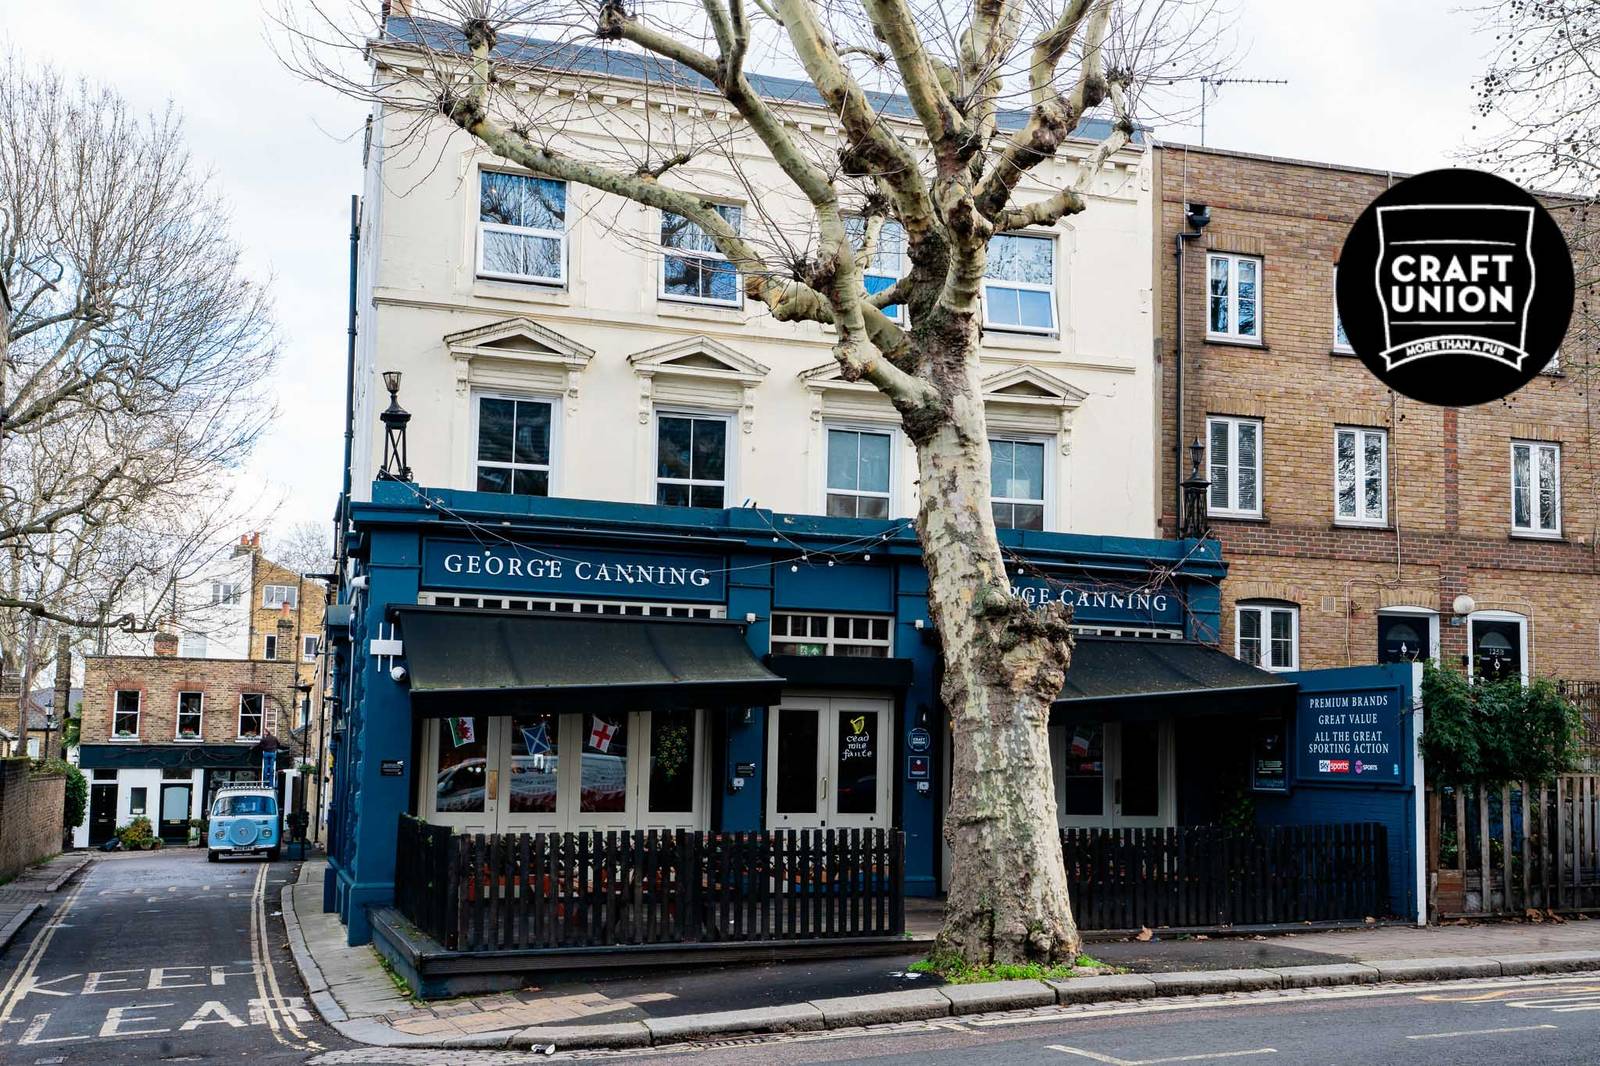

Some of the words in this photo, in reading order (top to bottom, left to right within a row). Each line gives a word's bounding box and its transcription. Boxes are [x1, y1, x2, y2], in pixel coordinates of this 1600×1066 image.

[444, 554, 563, 579] GEORGE
[575, 562, 709, 587] CANNING
[1060, 589, 1168, 612] CANNING
[1309, 698, 1348, 708] PREMIUM
[1352, 696, 1388, 706] BRANDS
[1318, 715, 1346, 724] GREAT
[1349, 714, 1378, 723] VALUE
[1315, 732, 1330, 741] ALL
[1333, 732, 1350, 741] THE
[1352, 731, 1382, 741] GREAT
[1308, 744, 1351, 754] SPORTING
[1353, 744, 1389, 754] ACTION
[1330, 762, 1349, 771] sports
